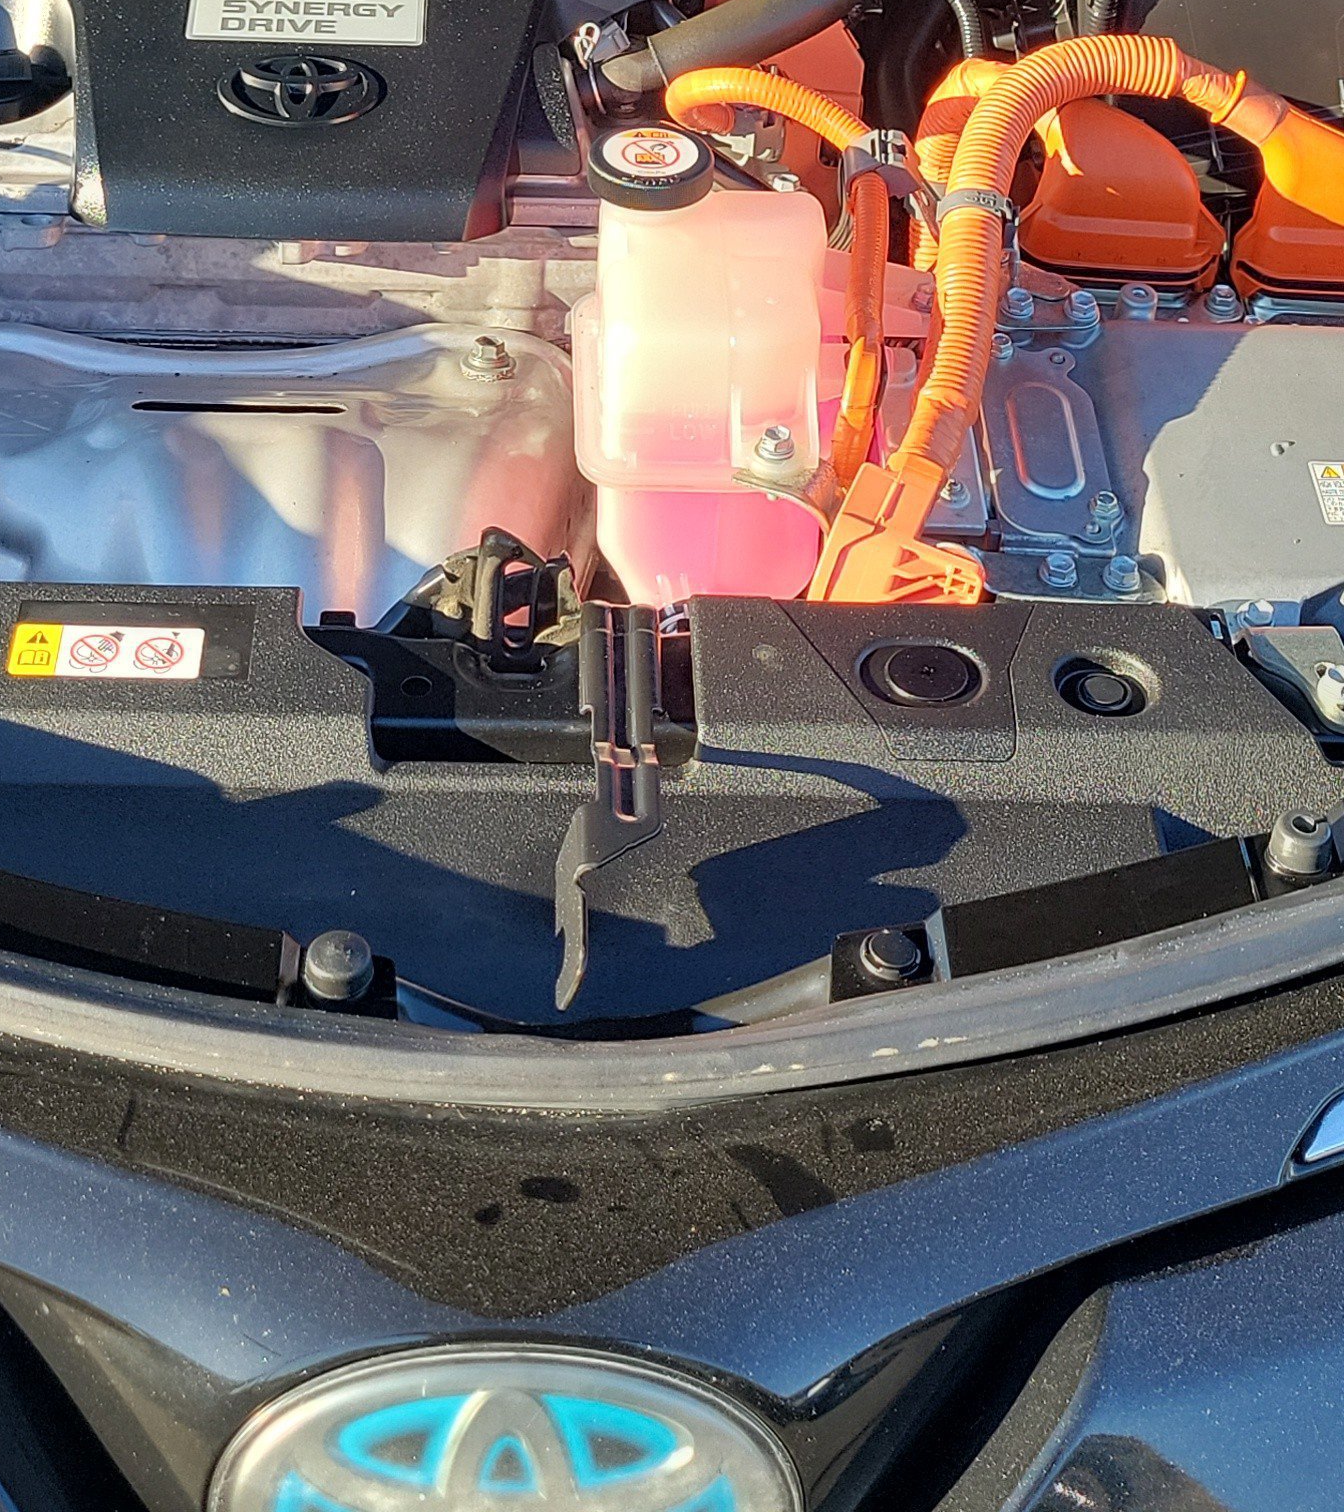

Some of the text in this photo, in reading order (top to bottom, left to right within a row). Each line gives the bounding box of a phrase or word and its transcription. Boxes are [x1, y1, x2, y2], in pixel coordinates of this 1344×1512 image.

[222, 0, 405, 18] SYNERGY
[220, 17, 337, 34] DRIVE
[667, 423, 716, 441] LOW
